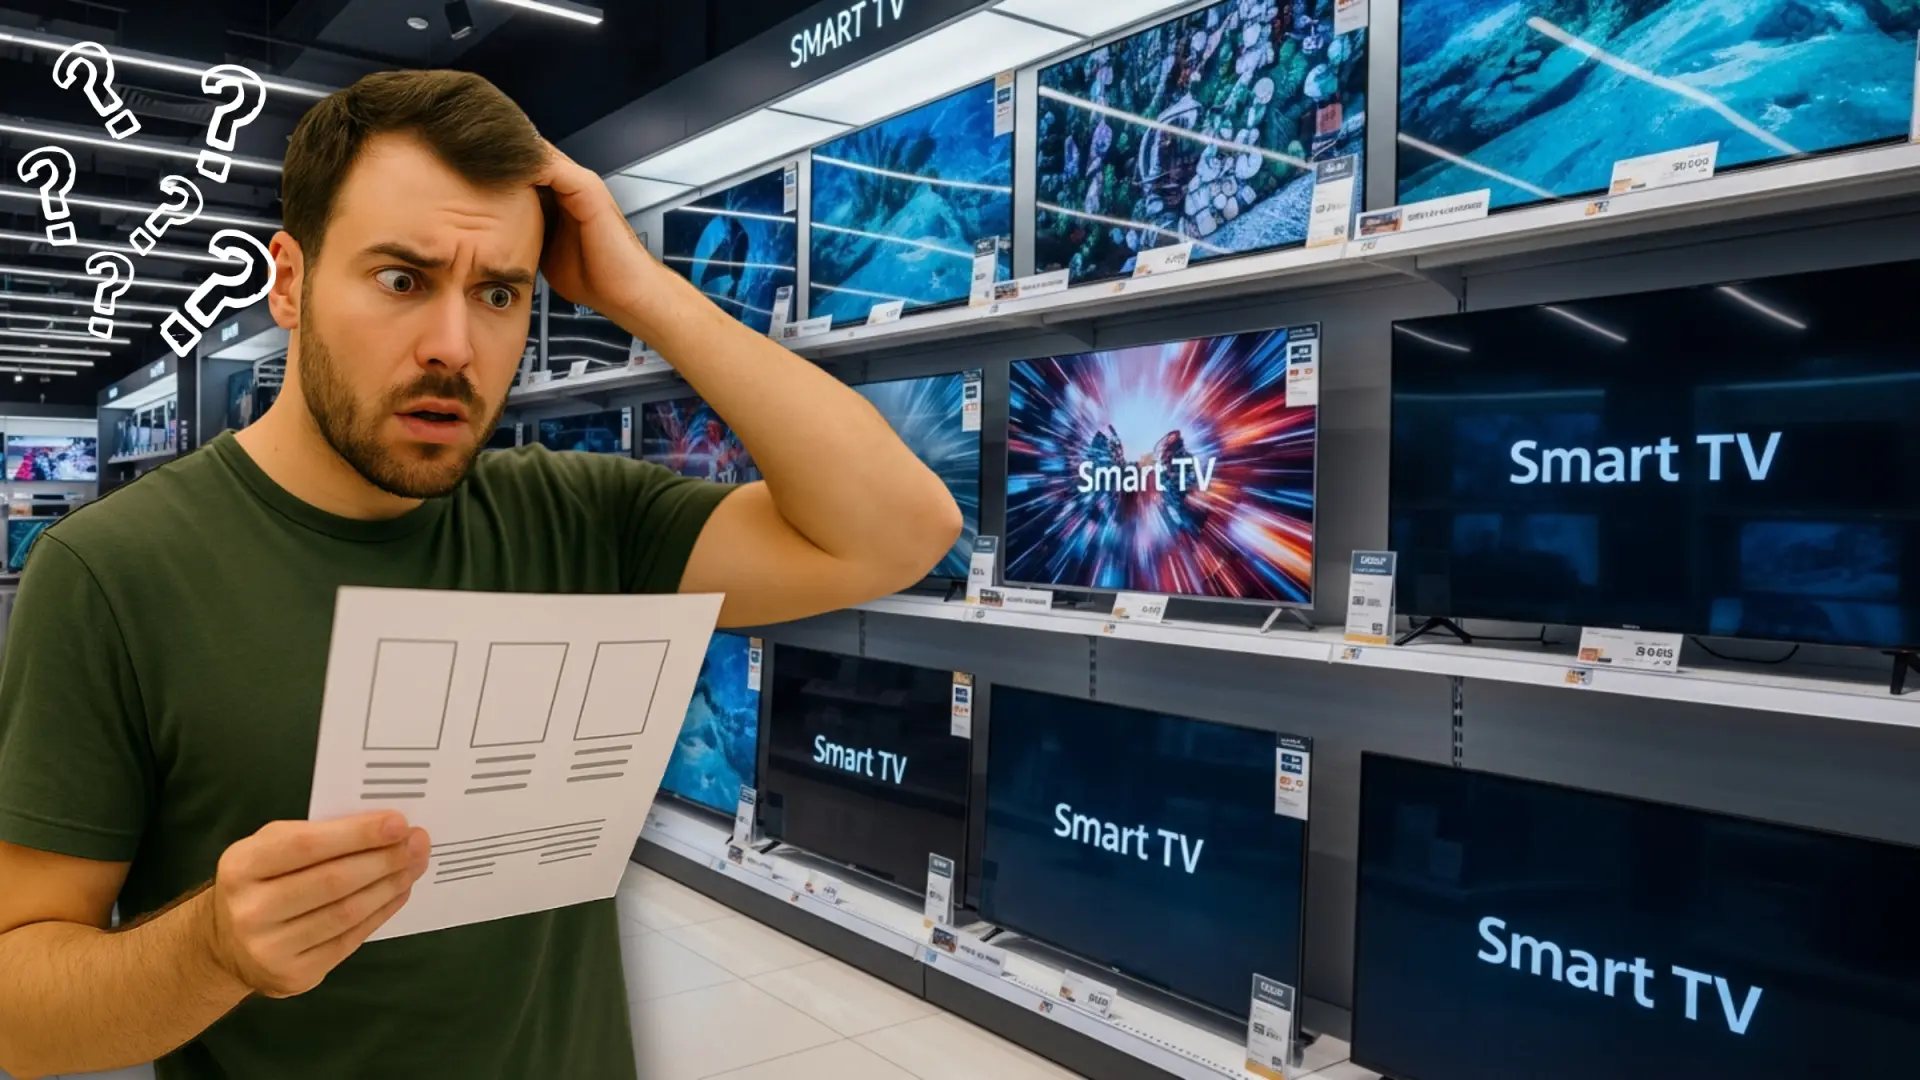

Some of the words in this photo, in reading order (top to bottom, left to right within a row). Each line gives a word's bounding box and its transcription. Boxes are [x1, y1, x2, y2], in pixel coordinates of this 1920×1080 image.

[790, 0, 867, 69] SMART
[872, 0, 905, 28] TV
[1077, 460, 1167, 493] Smart
[1170, 456, 1217, 492] TV
[1509, 437, 1679, 485] Smart
[1696, 432, 1782, 481] TV
[812, 733, 874, 778] Smart
[877, 749, 908, 785] TV
[1053, 802, 1149, 862] Smart
[1157, 829, 1204, 874] TV
[1477, 916, 1654, 1009] Smart
[1671, 965, 1763, 1035] TV
